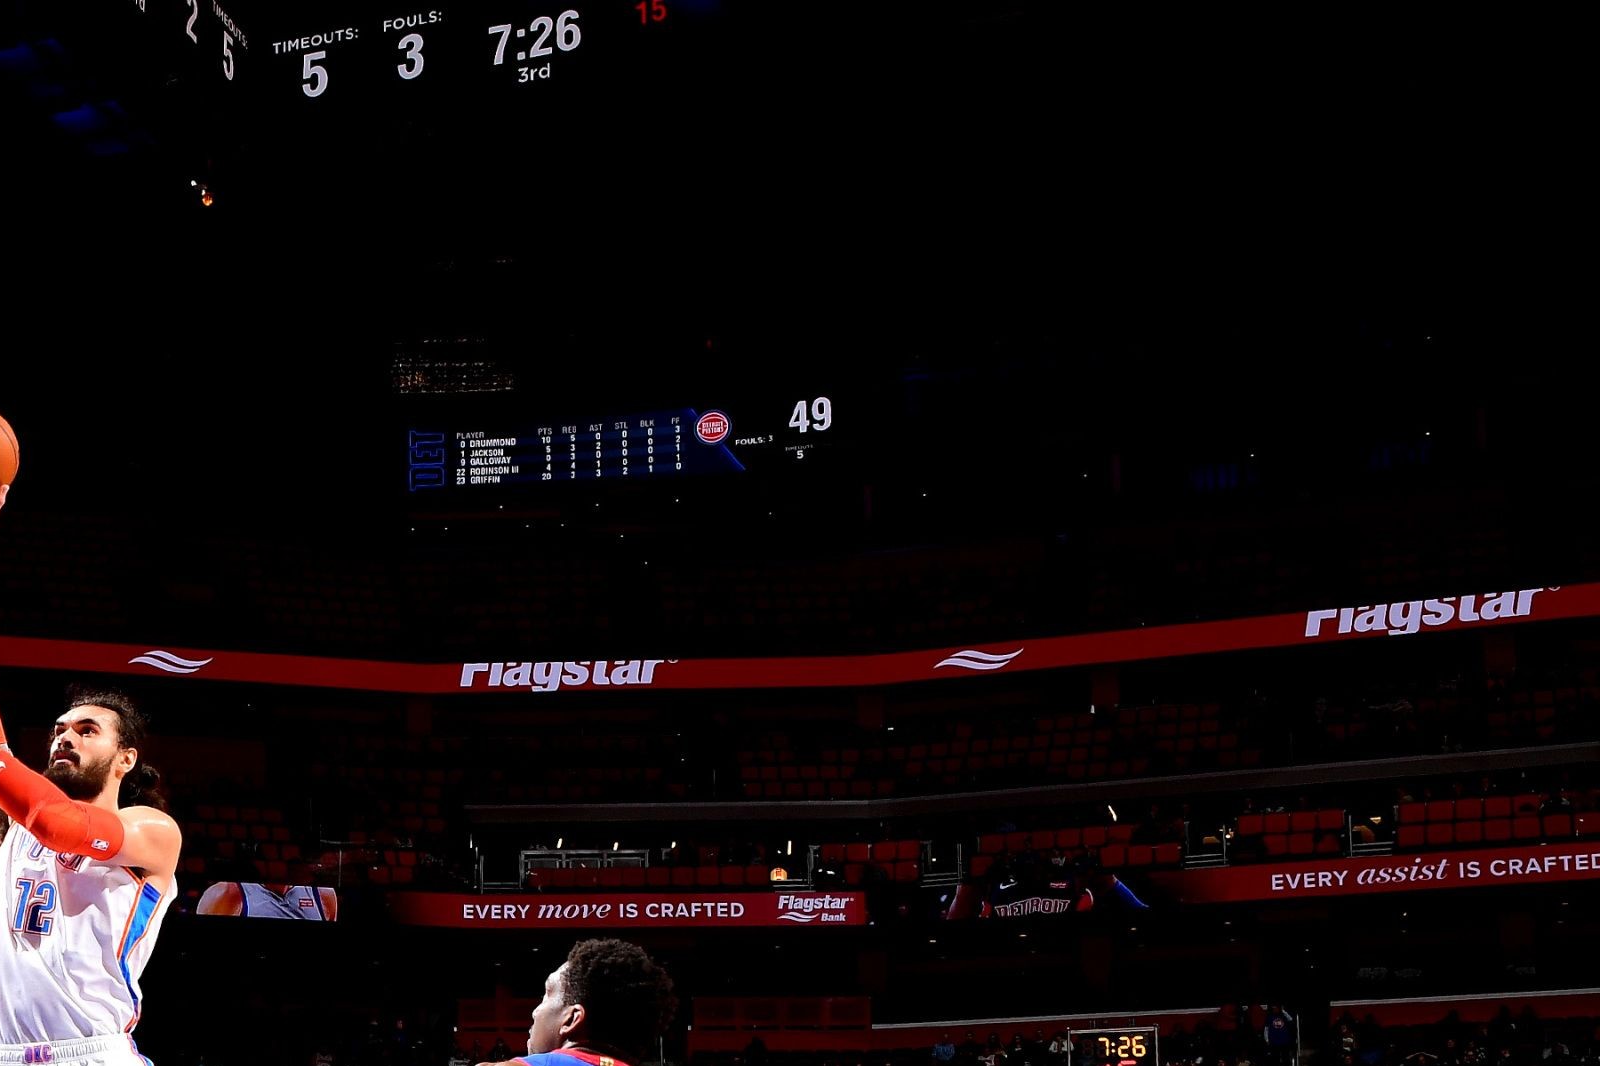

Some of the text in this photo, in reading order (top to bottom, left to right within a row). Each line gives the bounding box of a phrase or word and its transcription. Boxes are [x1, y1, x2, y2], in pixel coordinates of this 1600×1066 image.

[383, 10, 442, 32] FOULS:
[635, 0, 667, 25] 15
[272, 28, 359, 54] TIMEOUTS:
[488, 9, 581, 65] 7:26
[223, 31, 234, 81] 5
[397, 33, 424, 79] 3
[302, 51, 328, 97] 5
[518, 63, 551, 83] 3rd
[789, 397, 832, 433] 49
[456, 431, 484, 440] PLAYER
[538, 427, 552, 436] PTS
[589, 424, 602, 432] AST
[614, 422, 628, 430] STL
[541, 436, 551, 444] 10
[735, 437, 766, 446] FOULS:
[797, 450, 804, 459] 5
[1271, 853, 1600, 890] EVERY assist IS CRAFTED
[10, 877, 57, 936] 12
[463, 902, 745, 919] EVERY move IS CRAFTED
[777, 895, 849, 911] Flagstar
[821, 913, 846, 922] Bank
[1098, 1035, 1146, 1058] 7:26
